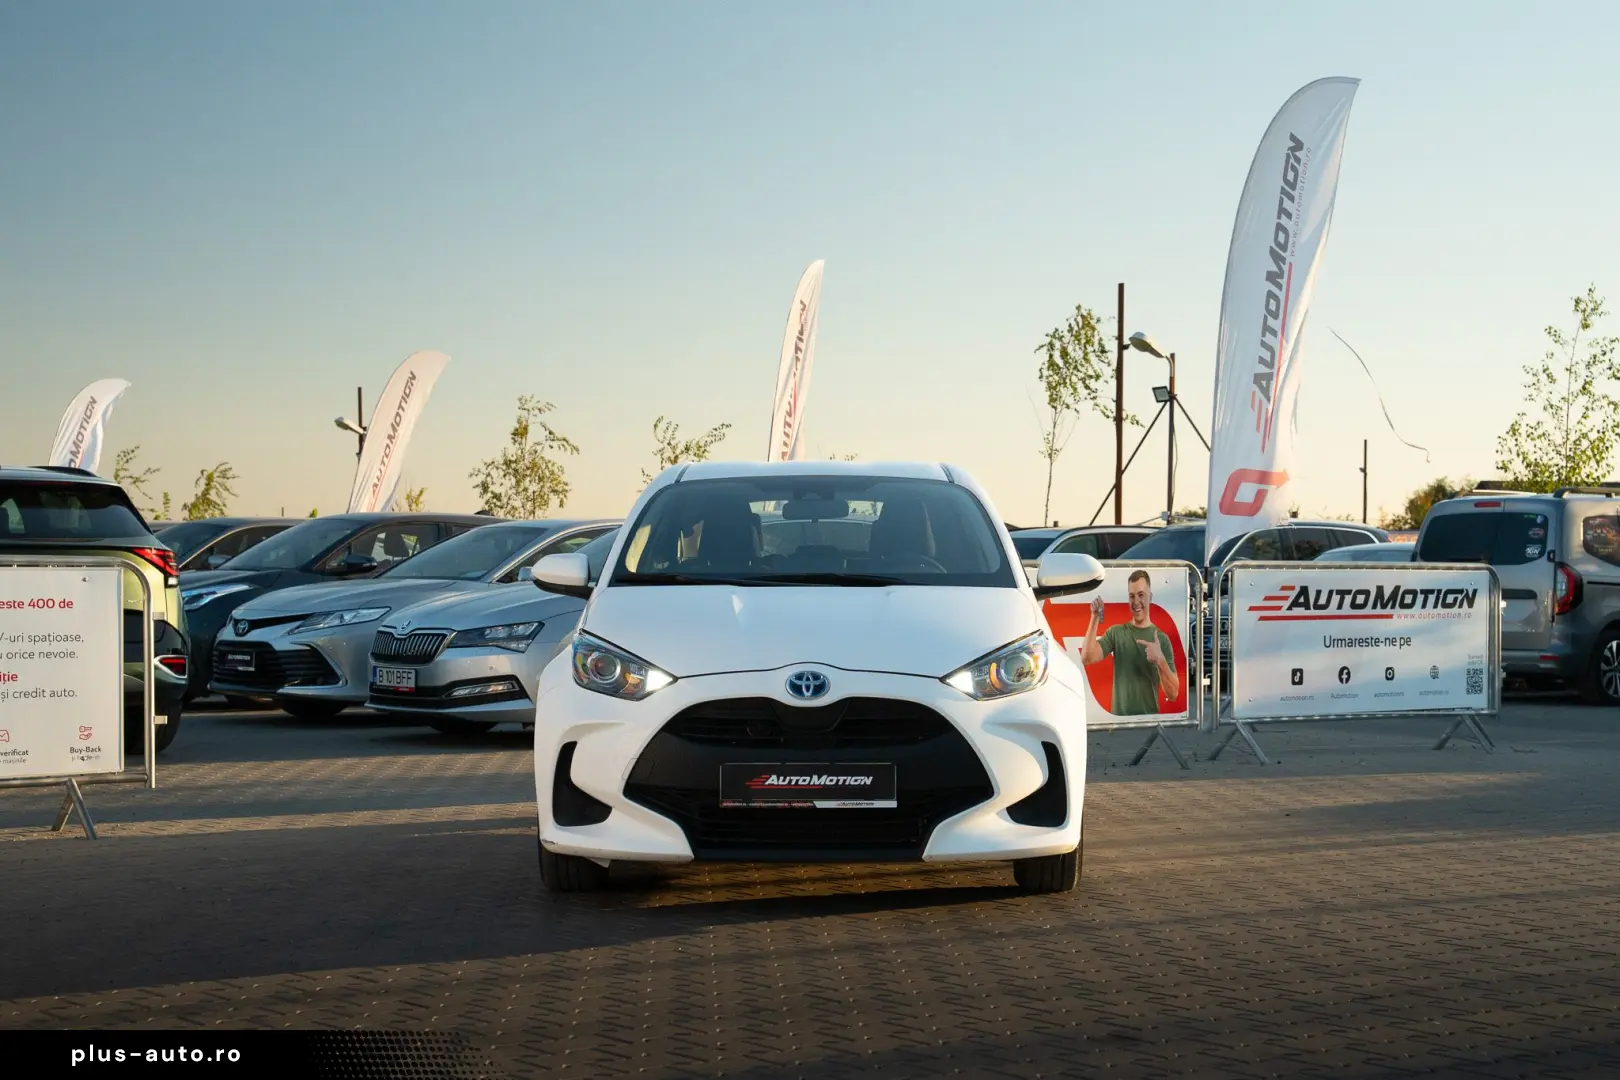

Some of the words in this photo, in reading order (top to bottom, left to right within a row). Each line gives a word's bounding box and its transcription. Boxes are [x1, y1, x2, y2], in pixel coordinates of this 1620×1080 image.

[28, 598, 55, 609] 400
[58, 598, 73, 609] de
[1397, 612, 1472, 620] www.automotion.ro
[28, 632, 84, 646] spațioase,
[1323, 635, 1397, 648] Urmareste-ne
[1399, 636, 1412, 650] pe
[6, 649, 35, 660] orice
[39, 649, 79, 659] nevoie.
[379, 670, 384, 683] B
[12, 687, 46, 699] credit
[49, 688, 78, 698] auto.
[70, 746, 102, 755] Buy-Back
[764, 774, 873, 785] AUTOMOTION
